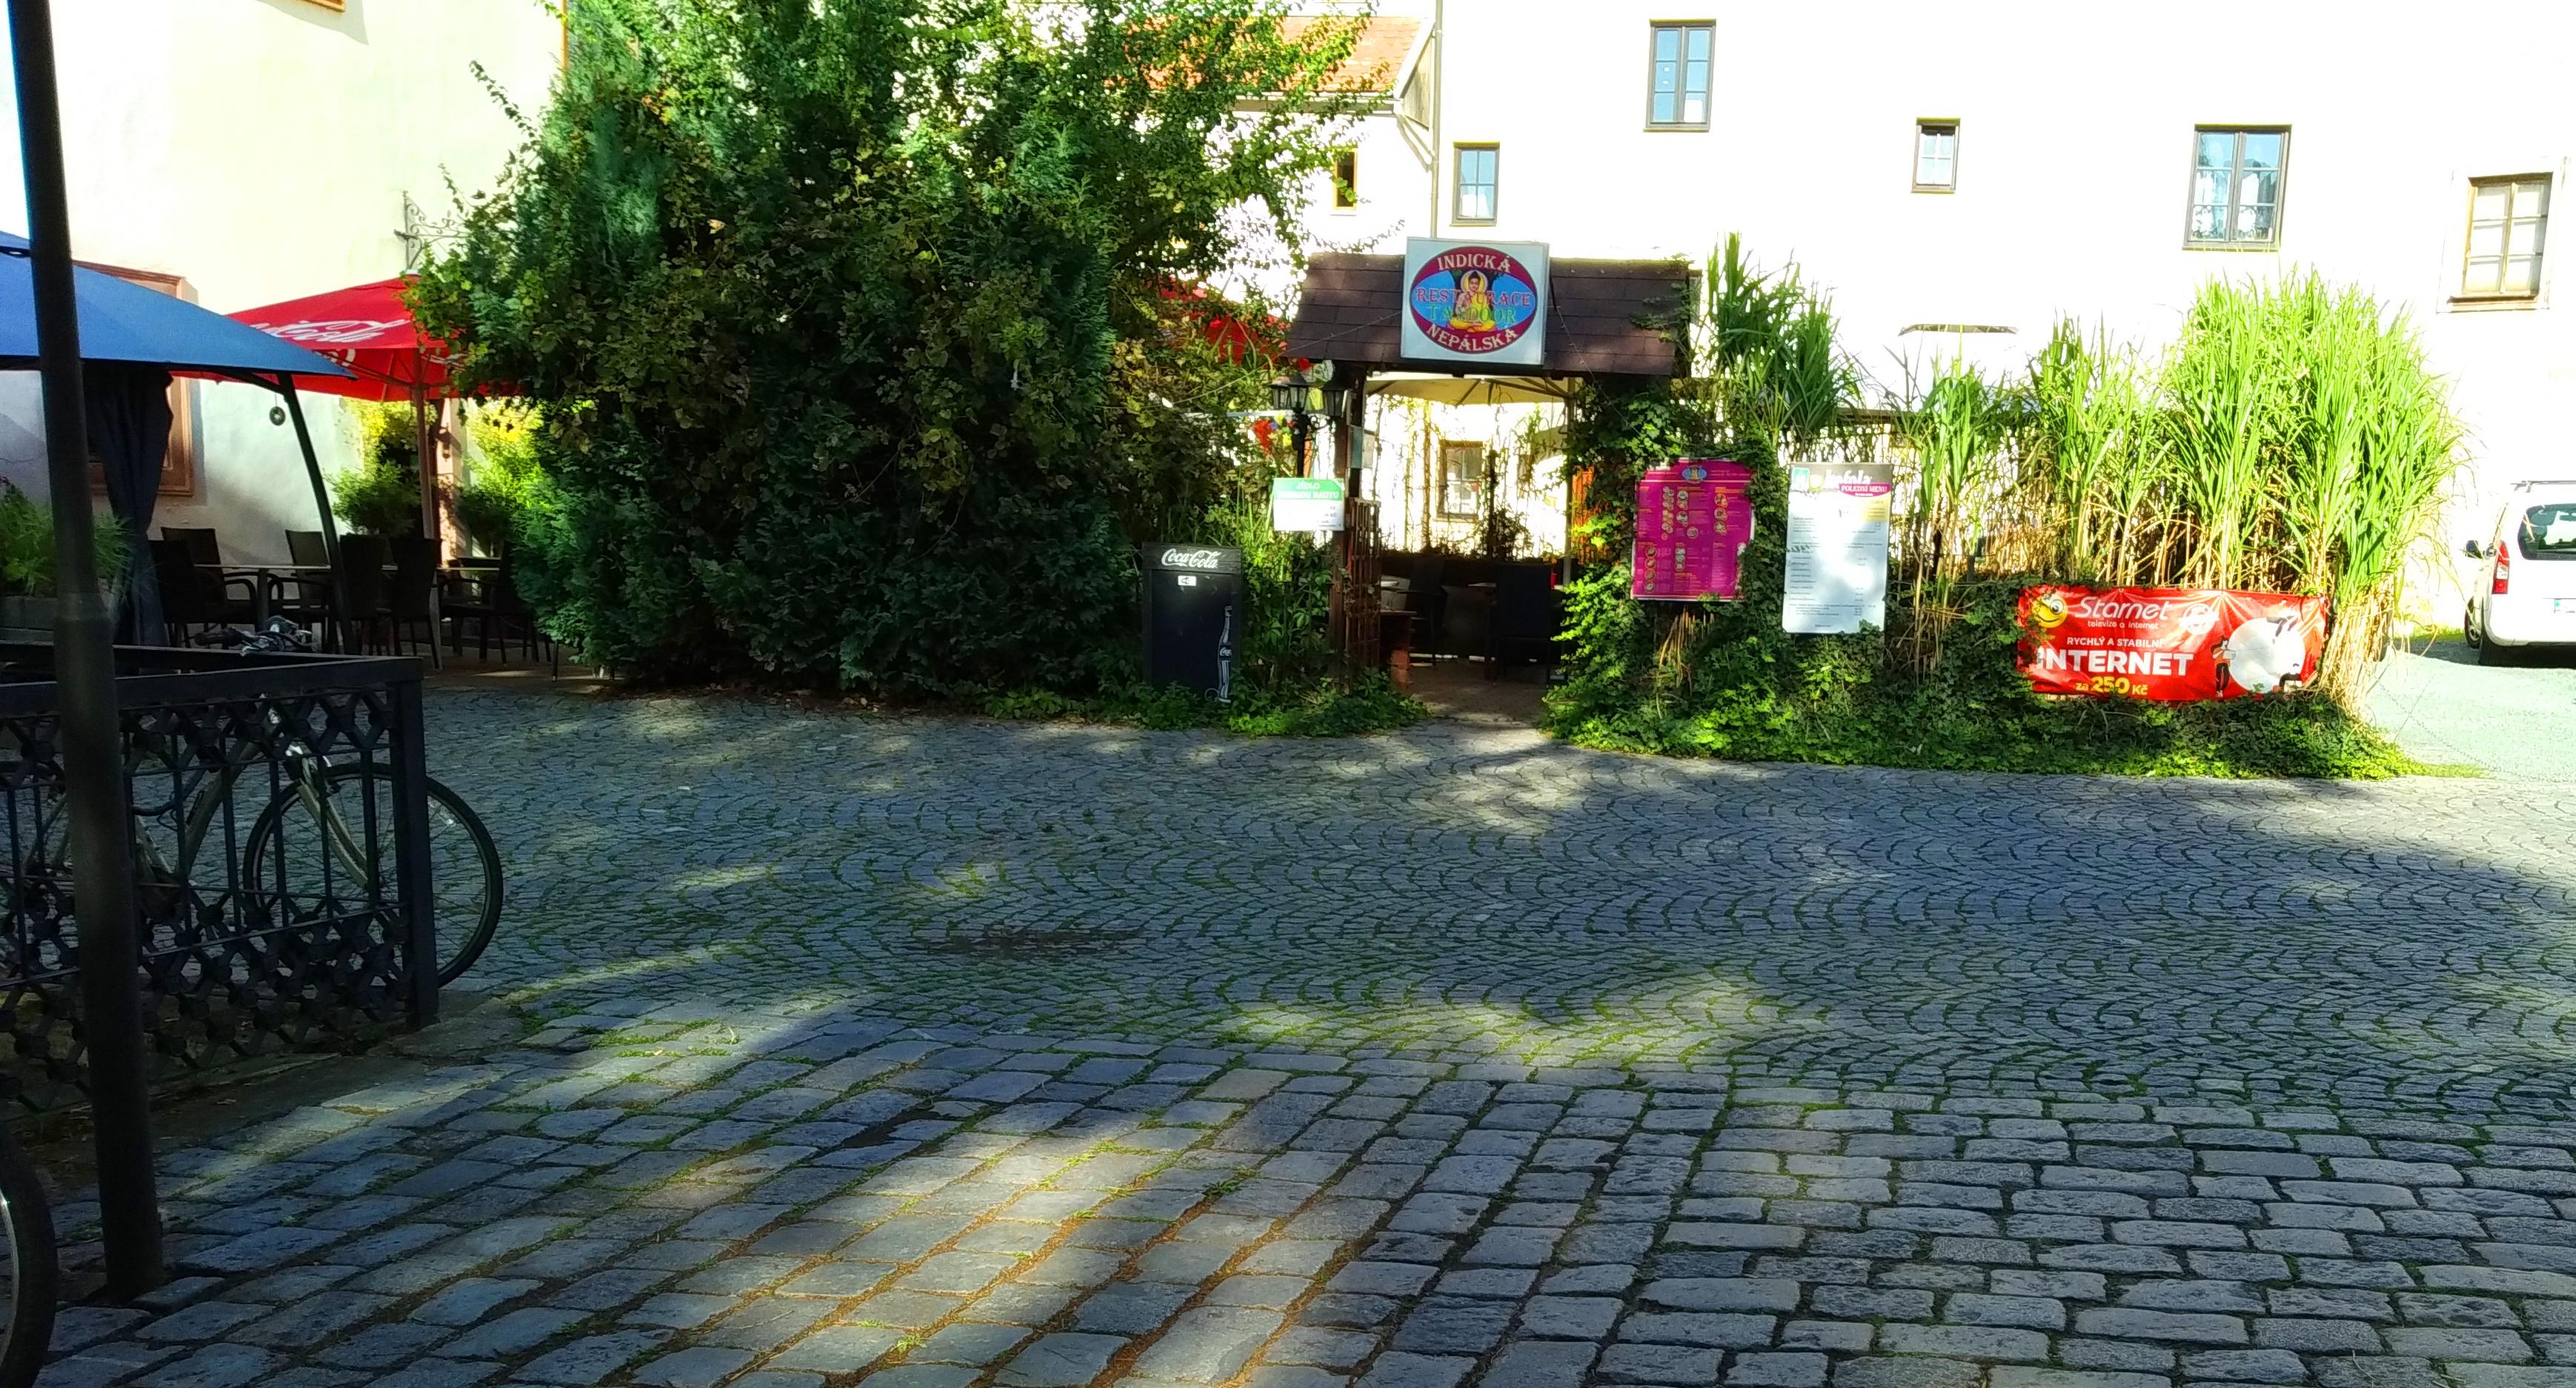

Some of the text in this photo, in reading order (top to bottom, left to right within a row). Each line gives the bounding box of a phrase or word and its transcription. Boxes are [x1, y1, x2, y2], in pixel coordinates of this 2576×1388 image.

[1437, 253, 1512, 273] INDICKÁ
[1416, 287, 1531, 307] RESTAURACE
[1427, 304, 1516, 324] TANDOOR
[1427, 324, 1519, 351] NEPÁLSKÁ
[1841, 484, 1868, 492] POLEDNÍ
[1161, 548, 1222, 569] Coca-Cola
[2074, 596, 2171, 620] Starnet
[2088, 620, 2117, 628] televize
[2128, 621, 2158, 630] internet
[2067, 636, 2164, 648] RYCHLÝ A STABILNÍ
[2037, 646, 2194, 677] INTERNET
[2075, 676, 2148, 695] za 250 Kč
